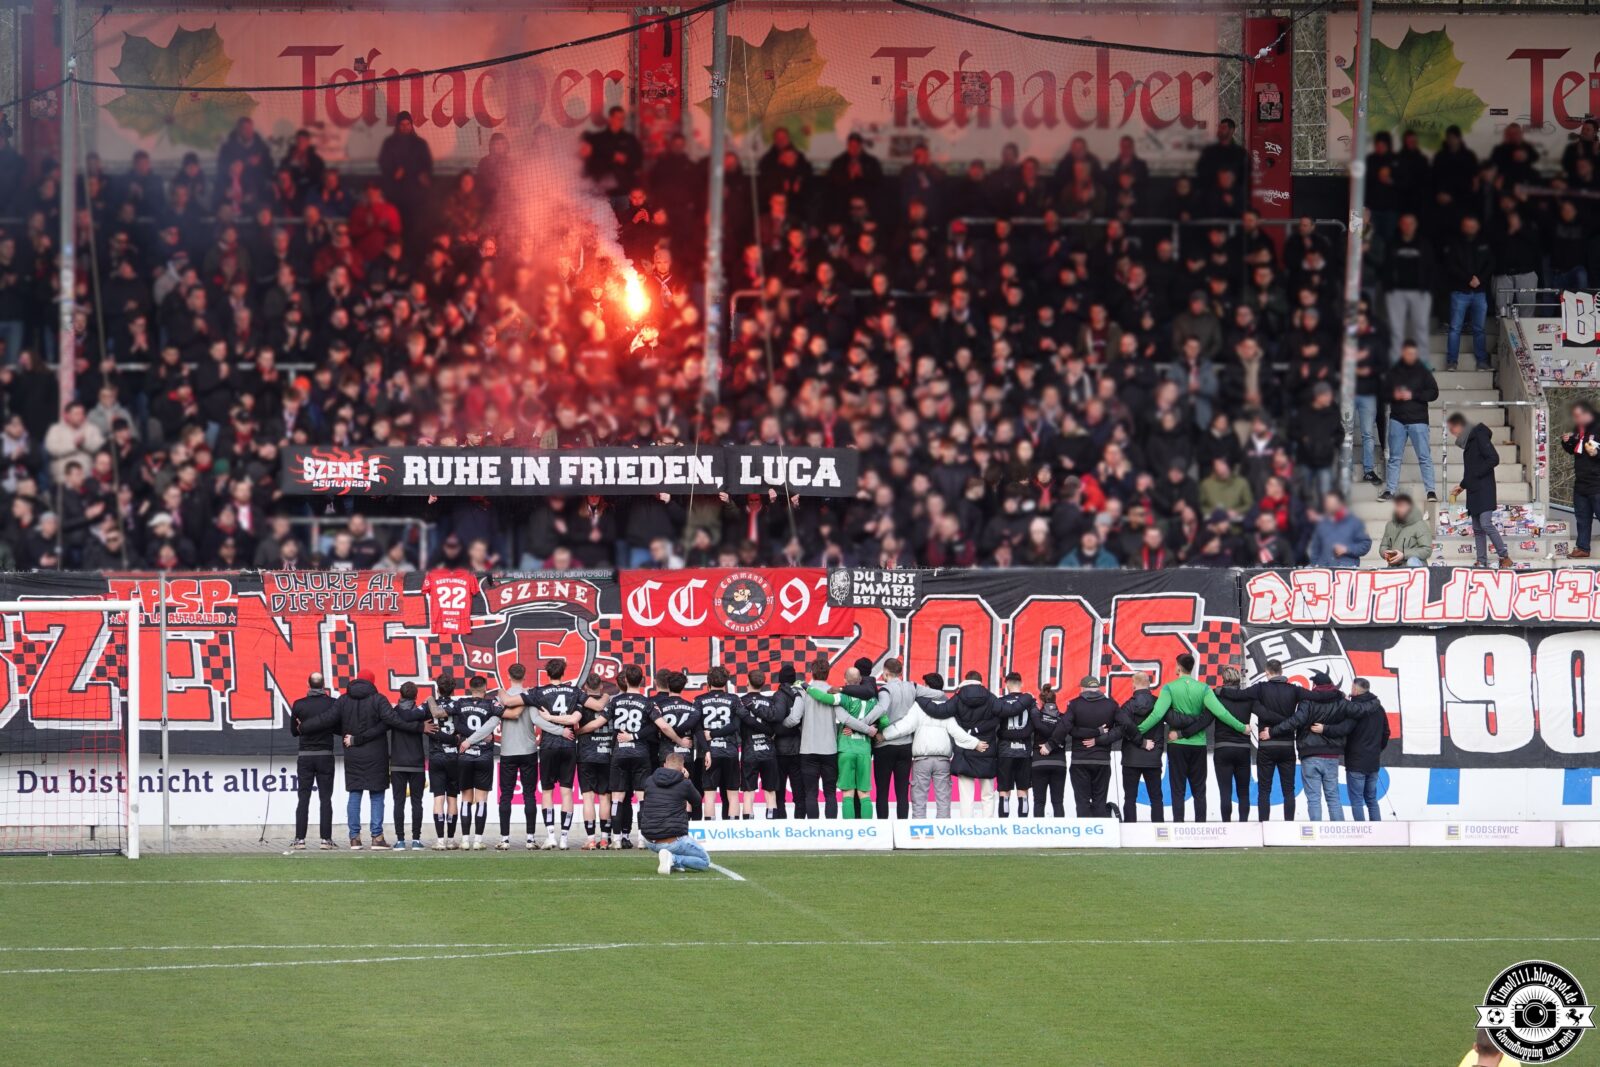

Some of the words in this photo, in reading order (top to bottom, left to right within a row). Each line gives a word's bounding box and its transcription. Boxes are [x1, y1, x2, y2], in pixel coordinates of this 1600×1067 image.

[871, 47, 1214, 131] Teinacher
[303, 456, 364, 481] SZENE
[368, 457, 380, 482] E
[403, 455, 501, 486] RUHE
[510, 455, 550, 486] IN
[559, 455, 724, 489] FRIEDEN,
[740, 455, 841, 488] LUCA
[312, 479, 372, 487] REUTLINGEN
[367, 572, 397, 591] AI
[853, 570, 876, 582] DU
[882, 571, 917, 584] BIST
[436, 586, 467, 609] 22
[500, 581, 588, 605] SZENE
[853, 581, 916, 597] IMMER
[271, 591, 399, 612] DIFFIDATI
[626, 578, 708, 627] CC
[852, 595, 876, 605] BEI
[881, 597, 917, 607] UNS!
[167, 612, 227, 624] AUTORIDAD
[471, 650, 493, 665] 20
[593, 662, 616, 678] 05
[552, 694, 568, 716] 4
[467, 715, 482, 732] 9
[614, 707, 643, 733] 28
[702, 706, 731, 730] 23
[17, 770, 60, 793] Du
[68, 768, 127, 793] bist
[138, 768, 214, 793] nicht
[707, 827, 781, 840] Volksbank
[785, 826, 853, 842] Backnang
[856, 826, 878, 838] eG
[936, 824, 1009, 837] Volksbank
[1013, 824, 1082, 838] Backnang
[1085, 823, 1104, 836] eG
[1174, 826, 1227, 836] FOODSERVICE
[1319, 825, 1373, 835] FOODSERVICE
[1465, 825, 1519, 835] FOODSERVICE
